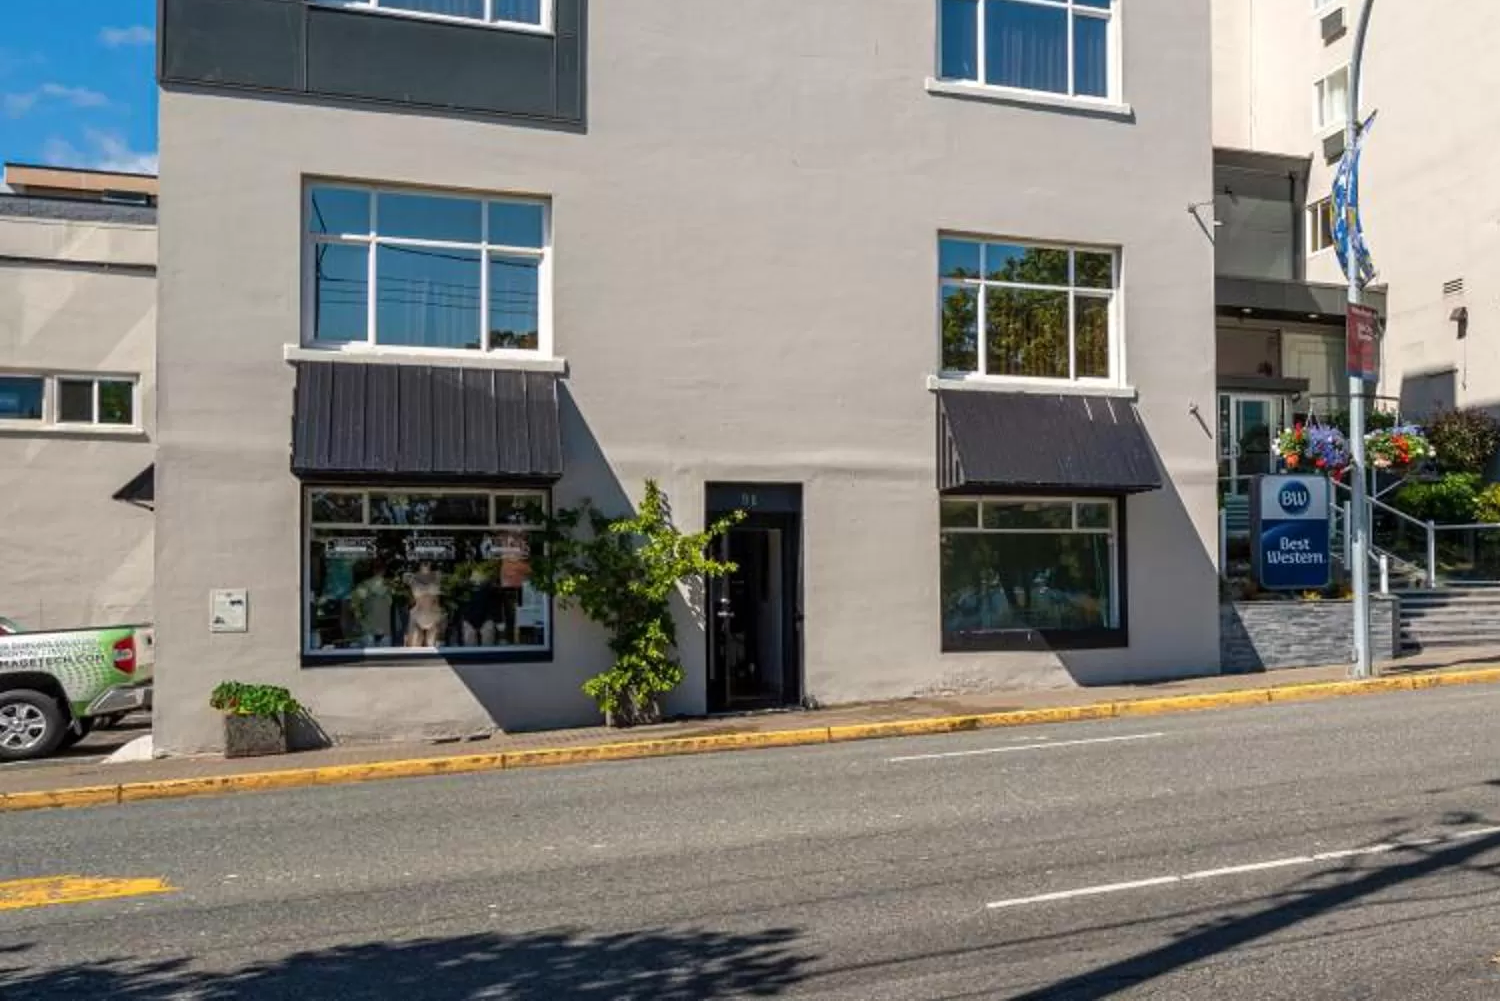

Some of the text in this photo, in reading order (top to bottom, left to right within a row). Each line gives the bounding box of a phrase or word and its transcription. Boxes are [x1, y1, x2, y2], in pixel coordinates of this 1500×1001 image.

[1281, 490, 1308, 506] BW
[1280, 536, 1311, 550] Best
[1266, 550, 1324, 564] Western
